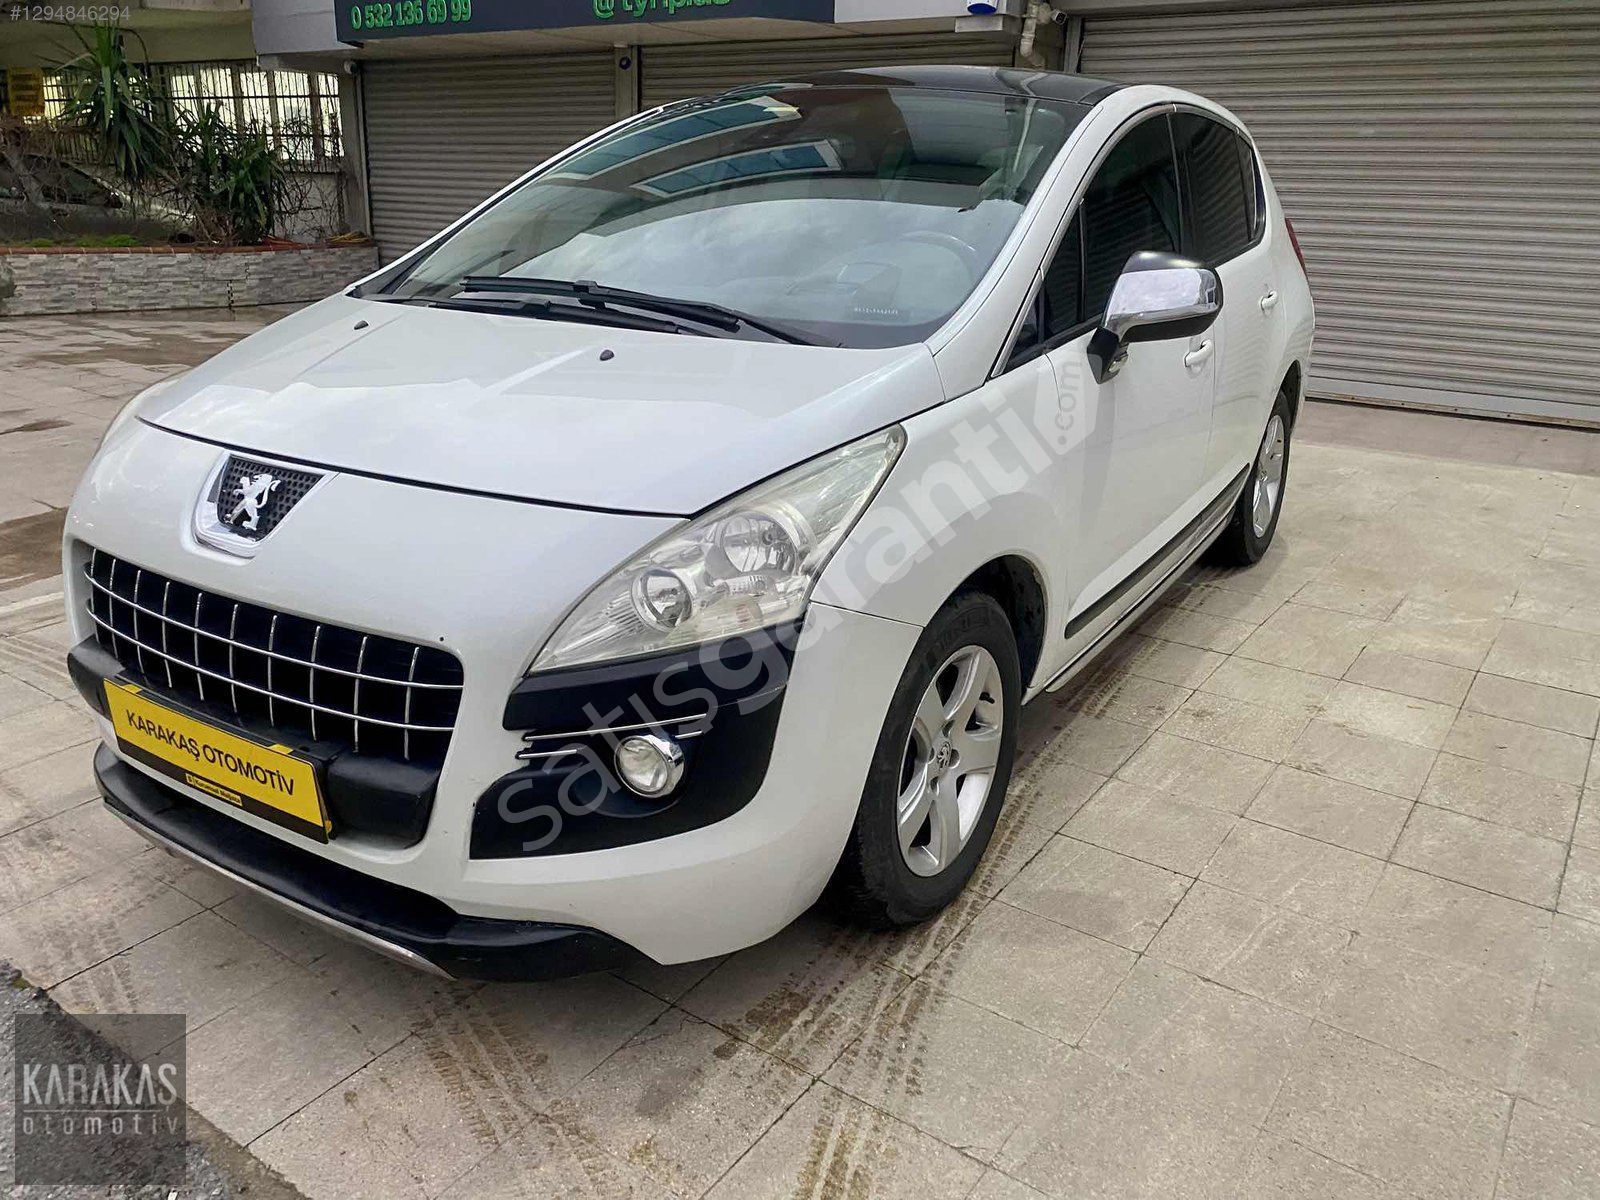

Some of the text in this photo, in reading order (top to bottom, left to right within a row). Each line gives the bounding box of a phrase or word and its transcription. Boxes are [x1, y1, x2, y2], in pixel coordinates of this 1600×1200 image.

[351, 5, 362, 29] 0
[364, 3, 393, 28] 532
[125, 708, 201, 762] KARAKAŞ
[202, 744, 295, 796] OTOMOTİV
